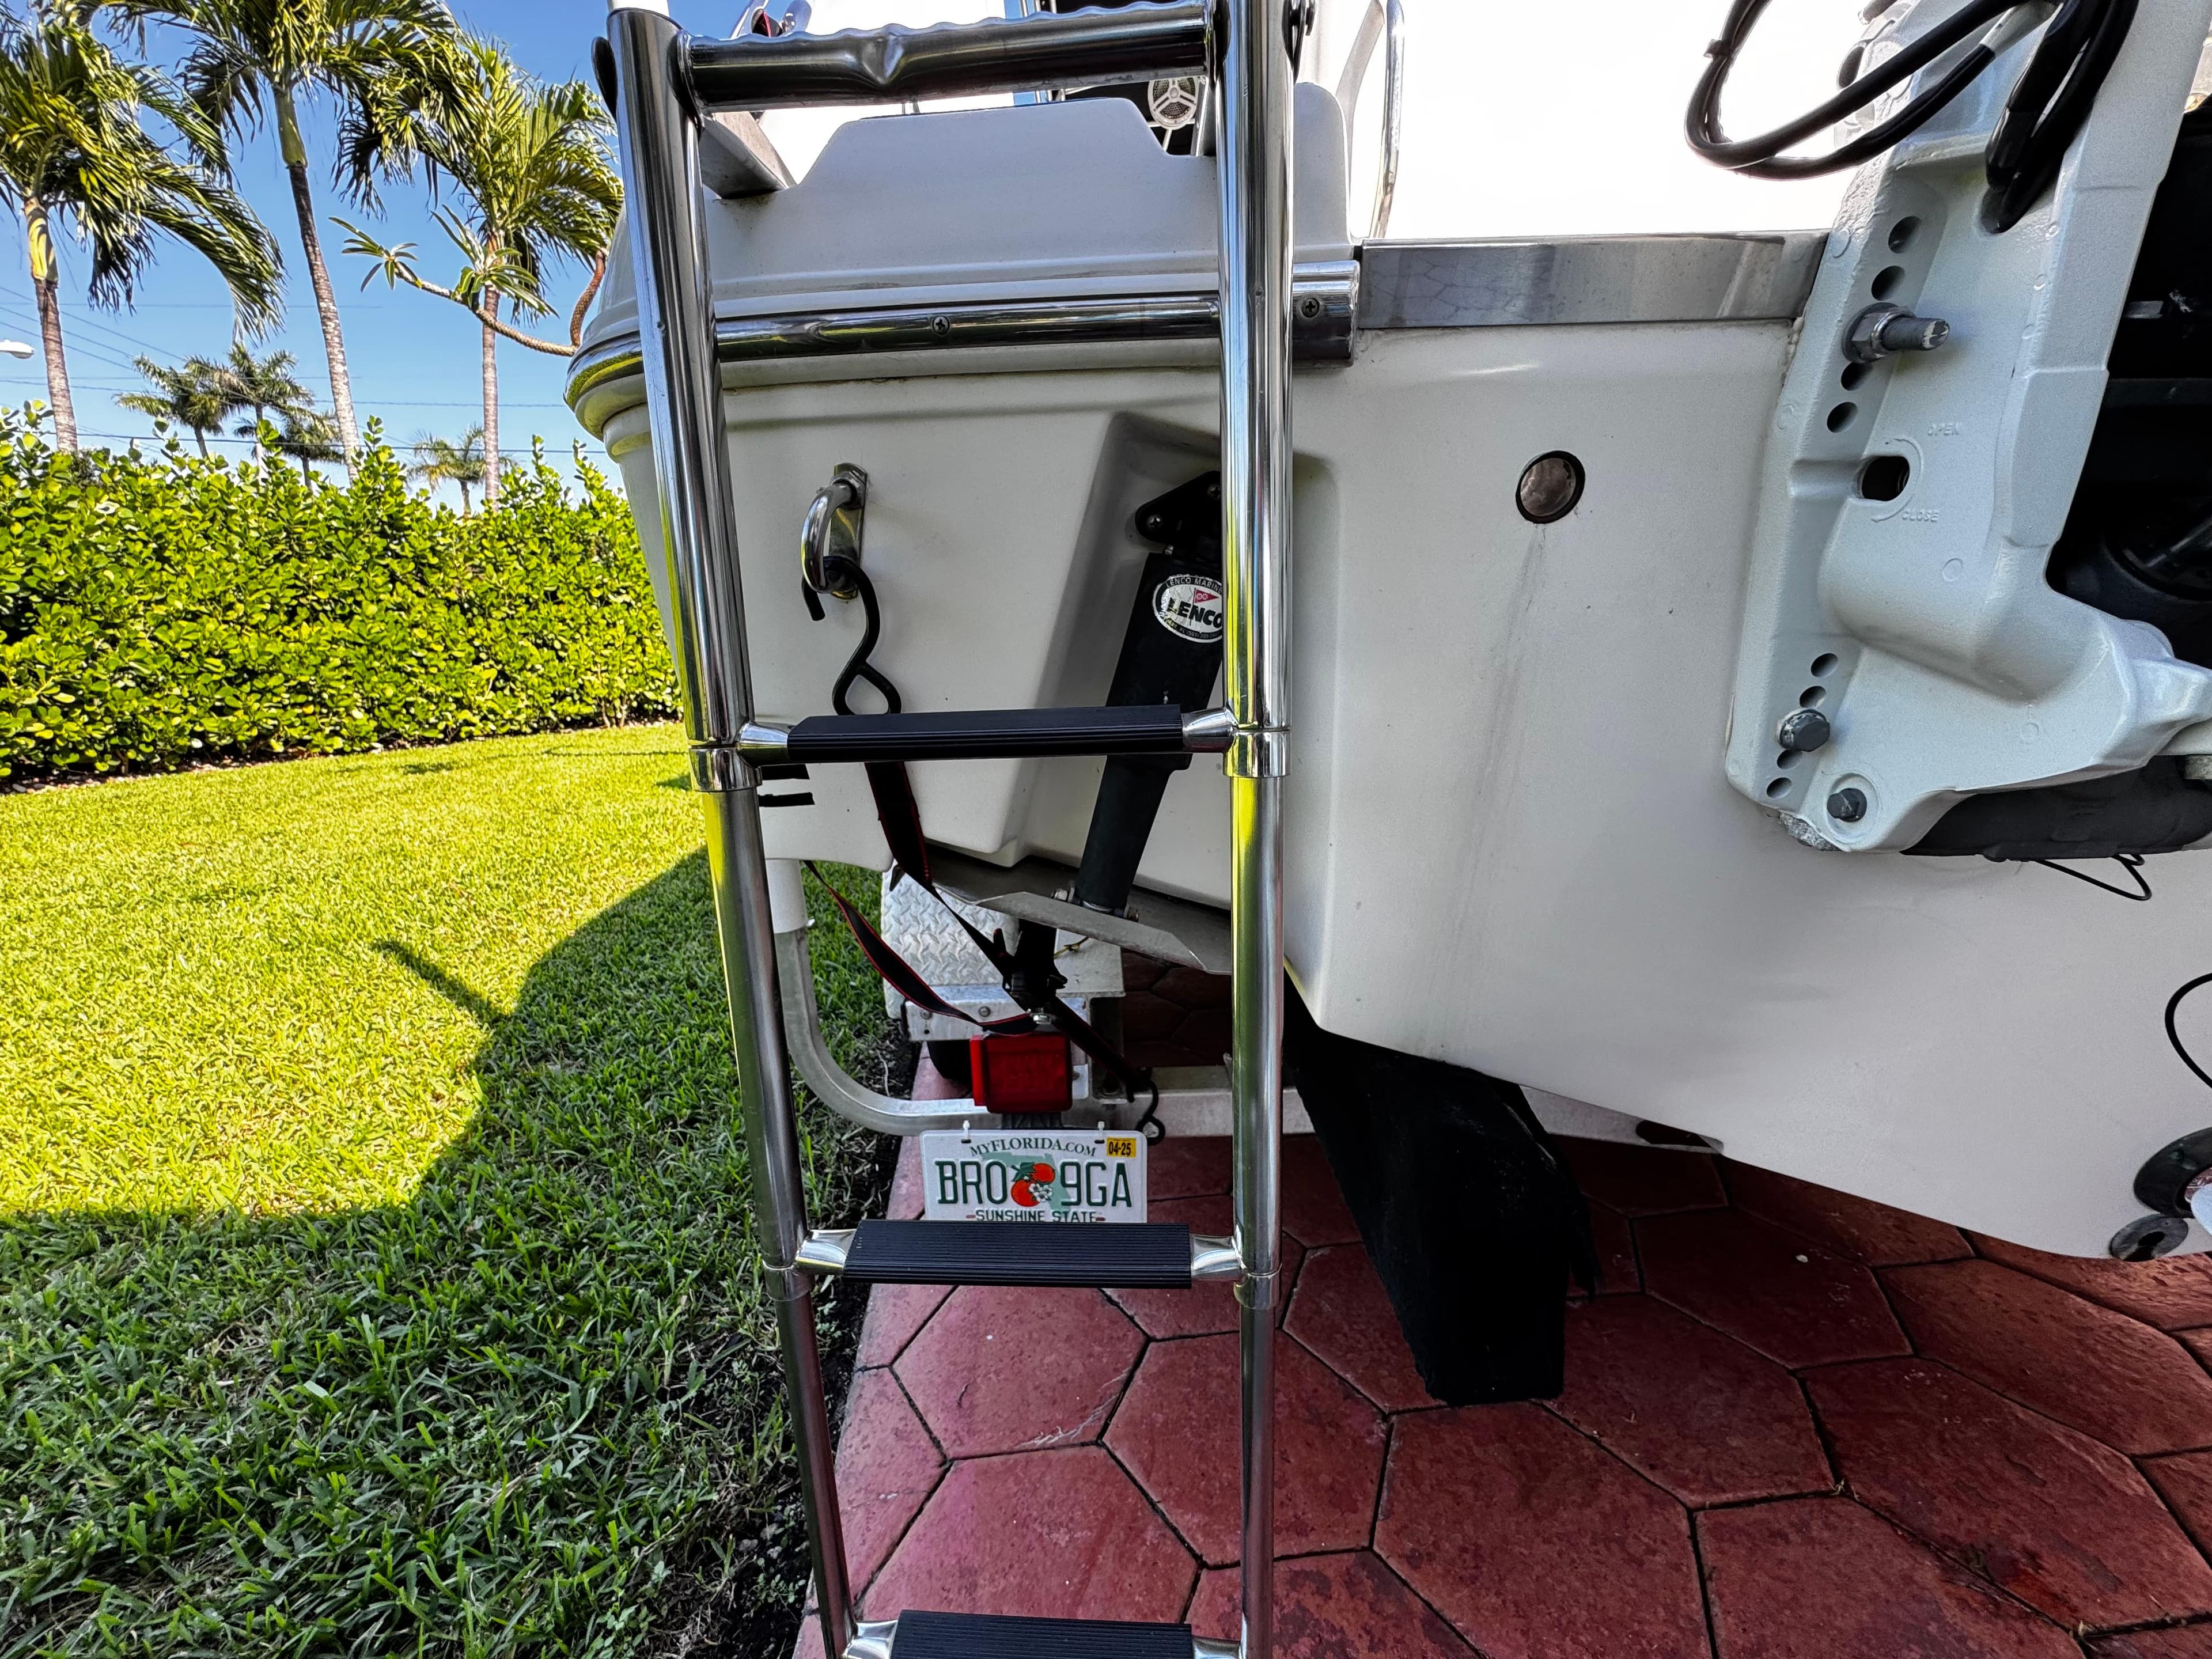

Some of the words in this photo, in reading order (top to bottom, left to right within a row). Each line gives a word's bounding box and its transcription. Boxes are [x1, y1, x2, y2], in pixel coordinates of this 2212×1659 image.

[1165, 577, 1191, 588] LENCO
[1166, 597, 1222, 628] LENCO
[970, 1137, 1096, 1157] MYFLORIDA.COM
[1108, 1141, 1131, 1156] 04-25
[1060, 1161, 1132, 1207] 9GA
[976, 1210, 1046, 1222] SUNSHINE
[1052, 1211, 1097, 1222] STATE
